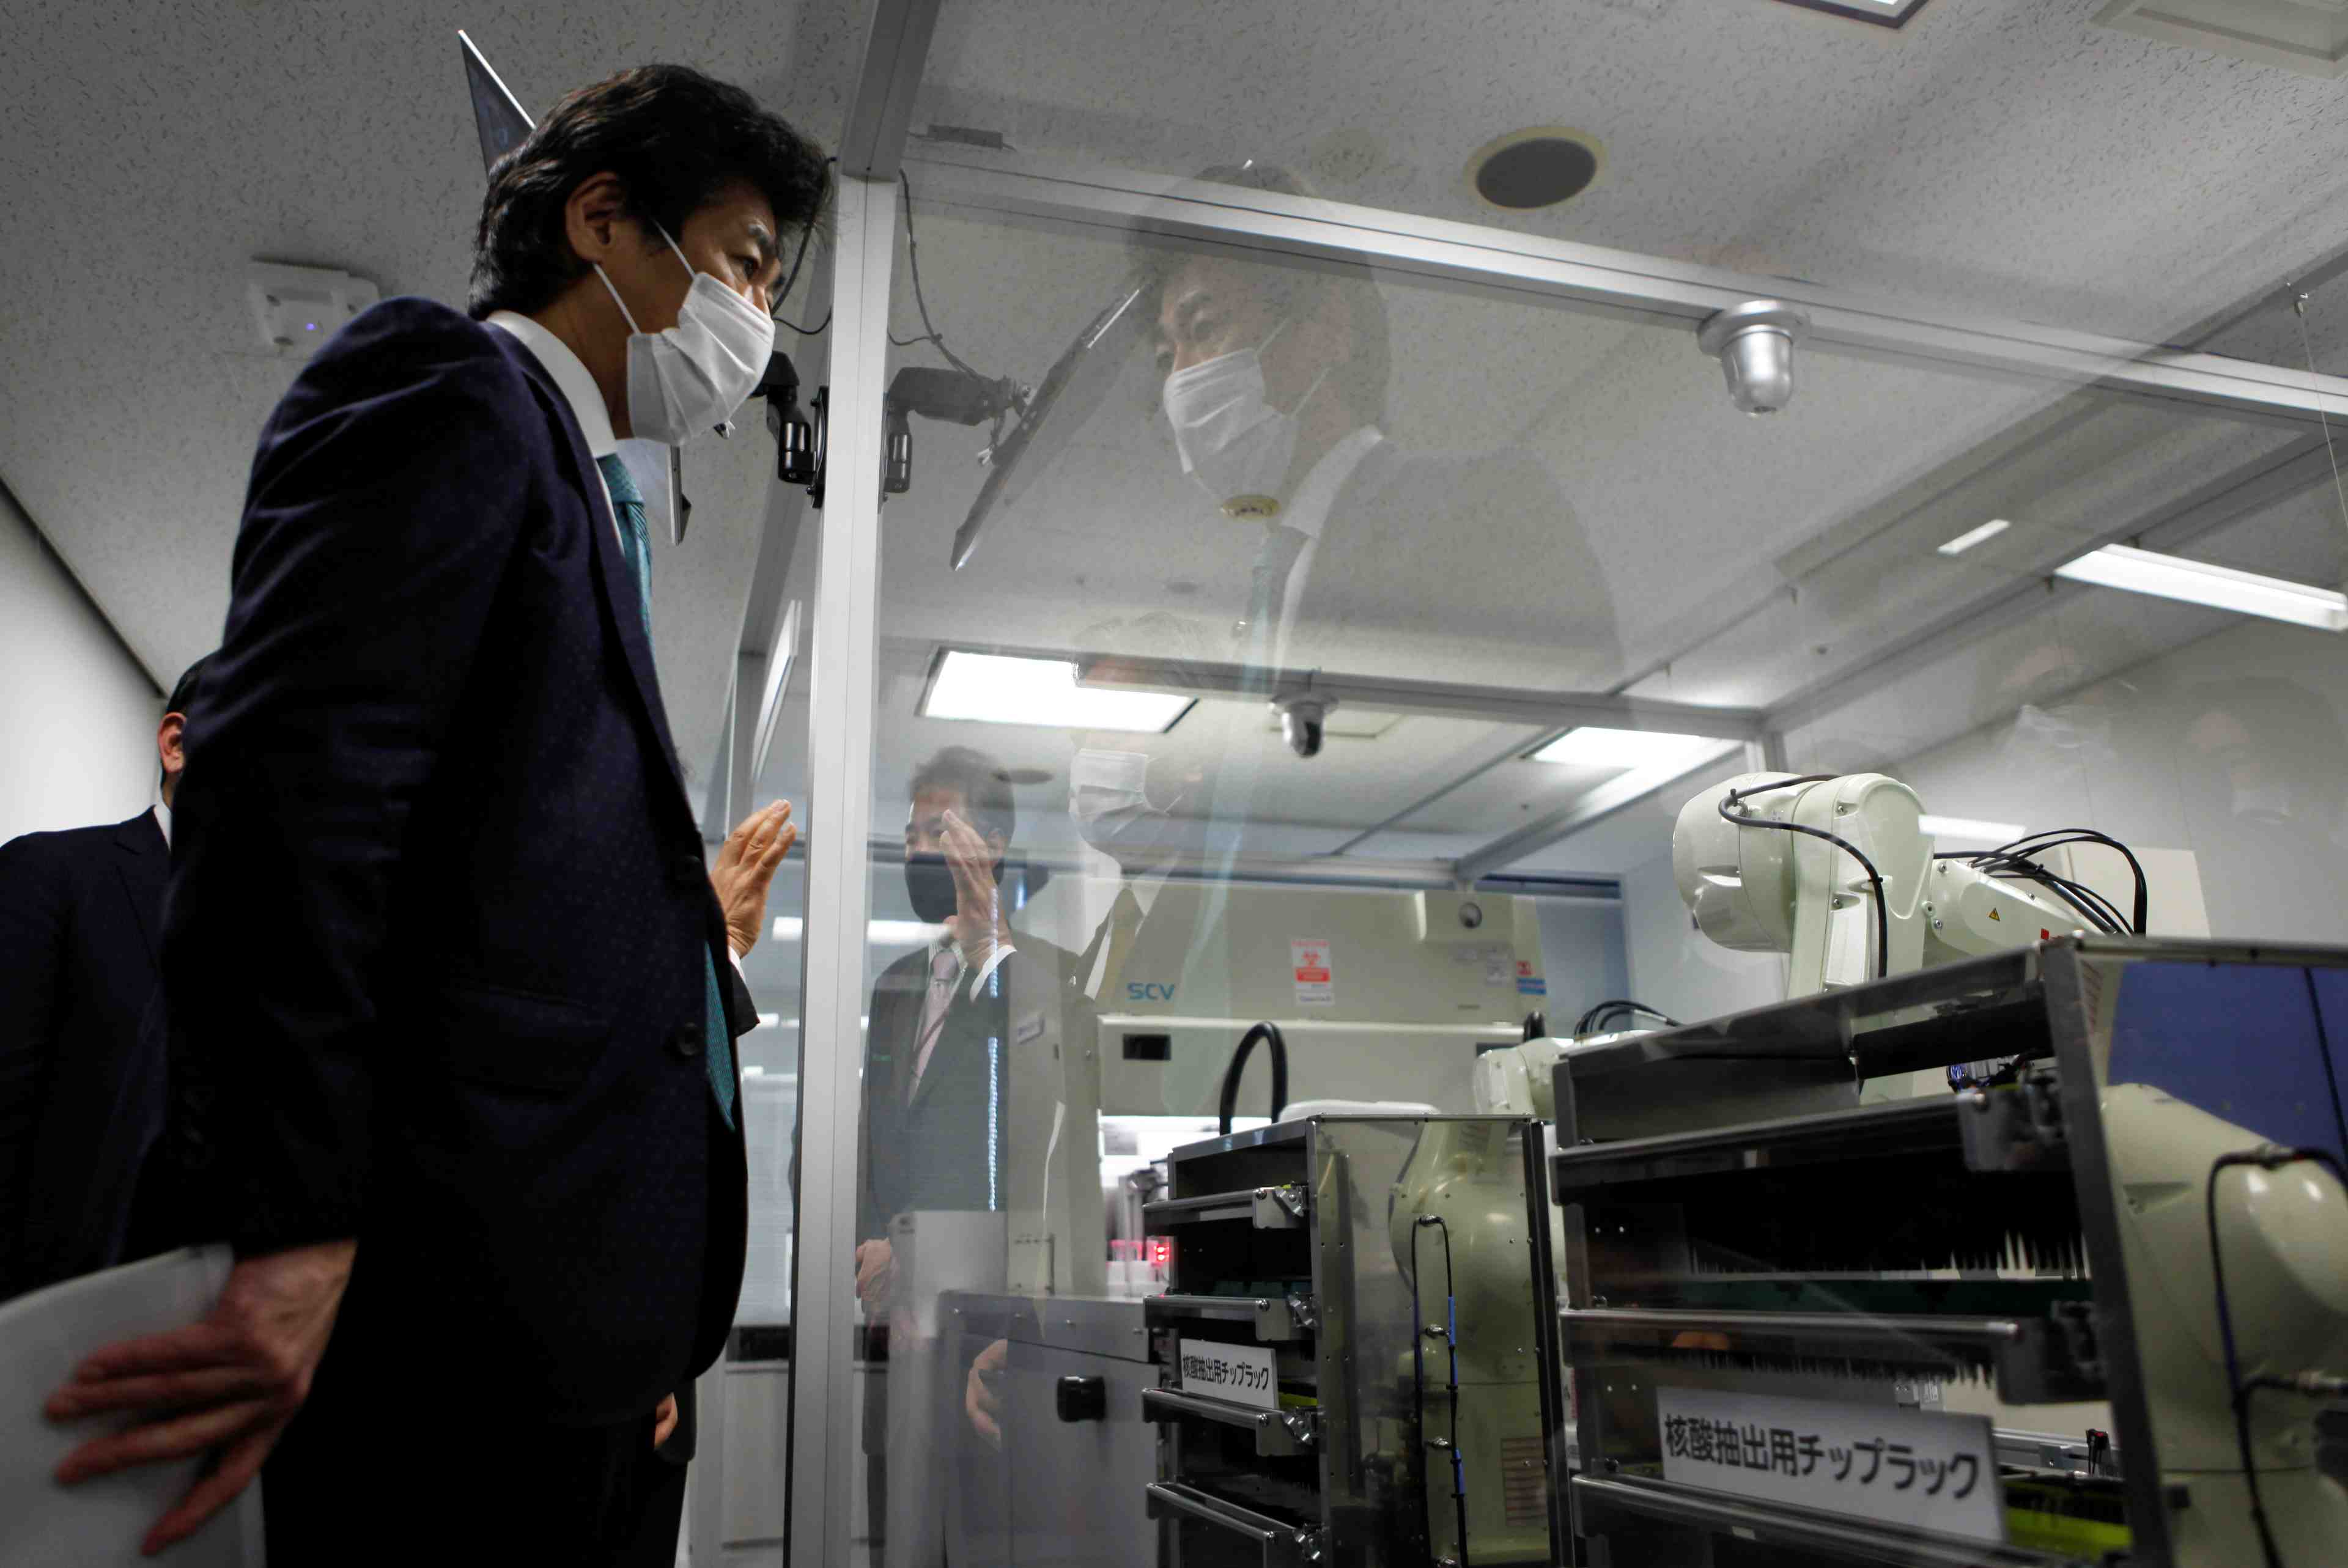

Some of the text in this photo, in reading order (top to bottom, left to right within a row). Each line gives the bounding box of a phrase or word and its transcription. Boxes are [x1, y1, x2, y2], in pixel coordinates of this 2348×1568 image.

[1126, 982, 1175, 1000] SCV
[1183, 1354, 1269, 1390] 核酸抽出用チップラック
[1664, 1413, 1979, 1499] 核酸抽出用チップラック
